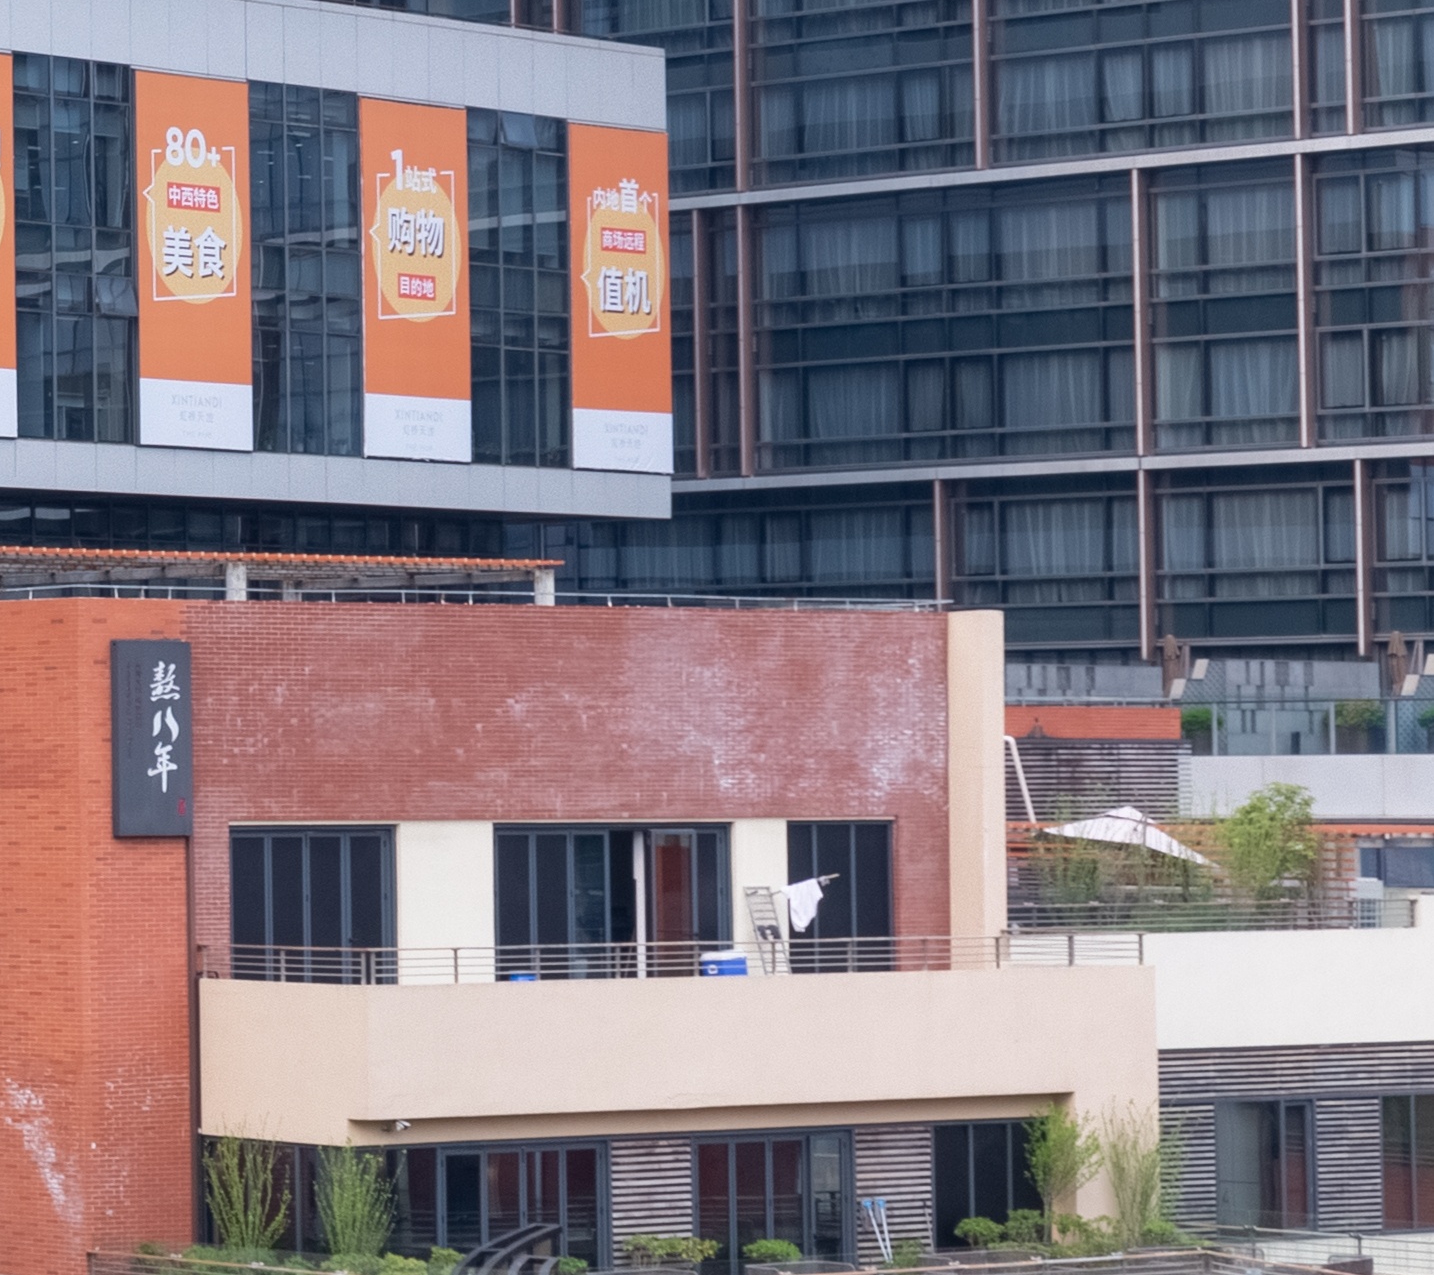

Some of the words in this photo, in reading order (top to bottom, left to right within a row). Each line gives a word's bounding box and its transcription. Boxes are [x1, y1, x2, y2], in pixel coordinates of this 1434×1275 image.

[165, 126, 221, 168] 80+
[390, 148, 437, 194] 1站式
[168, 184, 220, 210] 中西特色
[592, 177, 653, 215] 内地首个
[161, 224, 227, 279] 美食
[387, 205, 445, 258] 购物
[602, 229, 645, 252] 商场远程
[399, 275, 435, 298] 目的地
[597, 265, 652, 315] 值机
[171, 394, 222, 409] XINTIANDI
